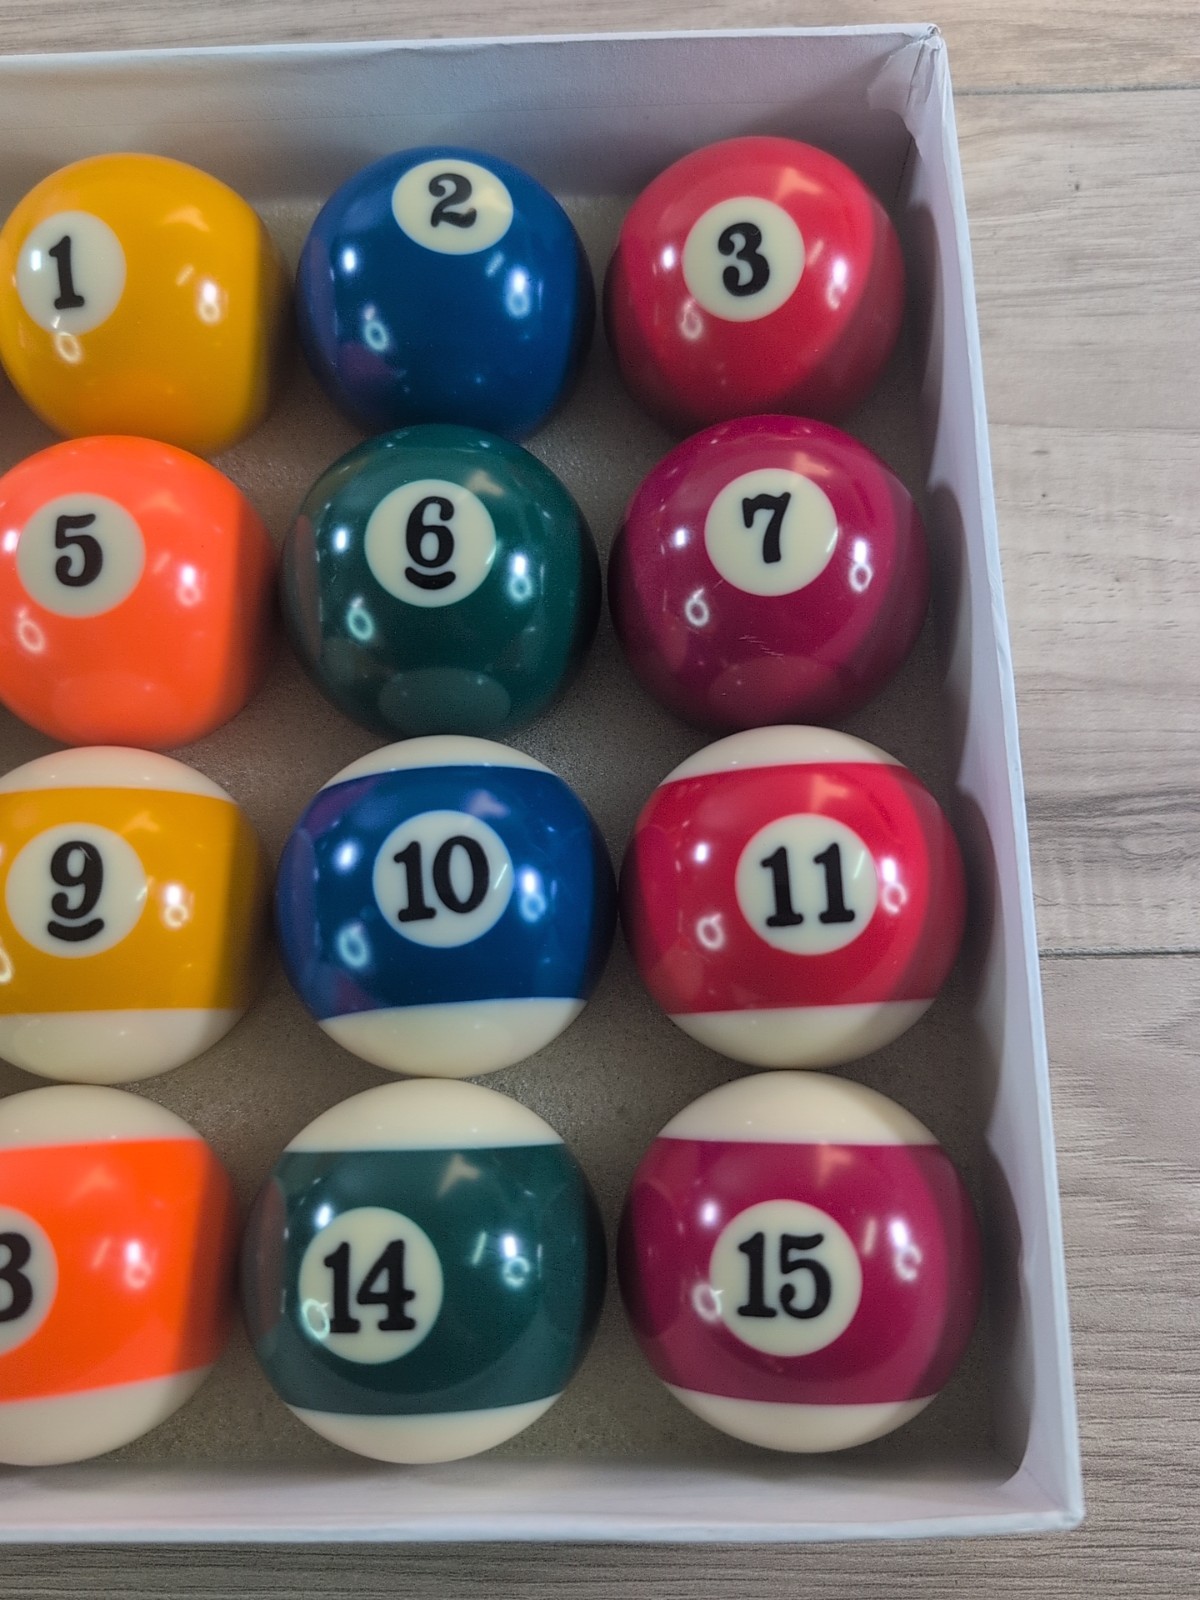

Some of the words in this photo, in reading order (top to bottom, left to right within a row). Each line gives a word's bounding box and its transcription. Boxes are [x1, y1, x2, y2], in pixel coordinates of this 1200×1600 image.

[428, 172, 478, 229] 2
[48, 234, 86, 311] 1
[717, 221, 771, 298] 3
[54, 513, 104, 588] 5
[403, 495, 457, 592] 6
[741, 491, 792, 565] 7
[46, 840, 106, 944] 9
[392, 834, 491, 924] 10
[759, 842, 856, 930] 11
[322, 1238, 418, 1336] 14
[735, 1231, 833, 1321] 15
